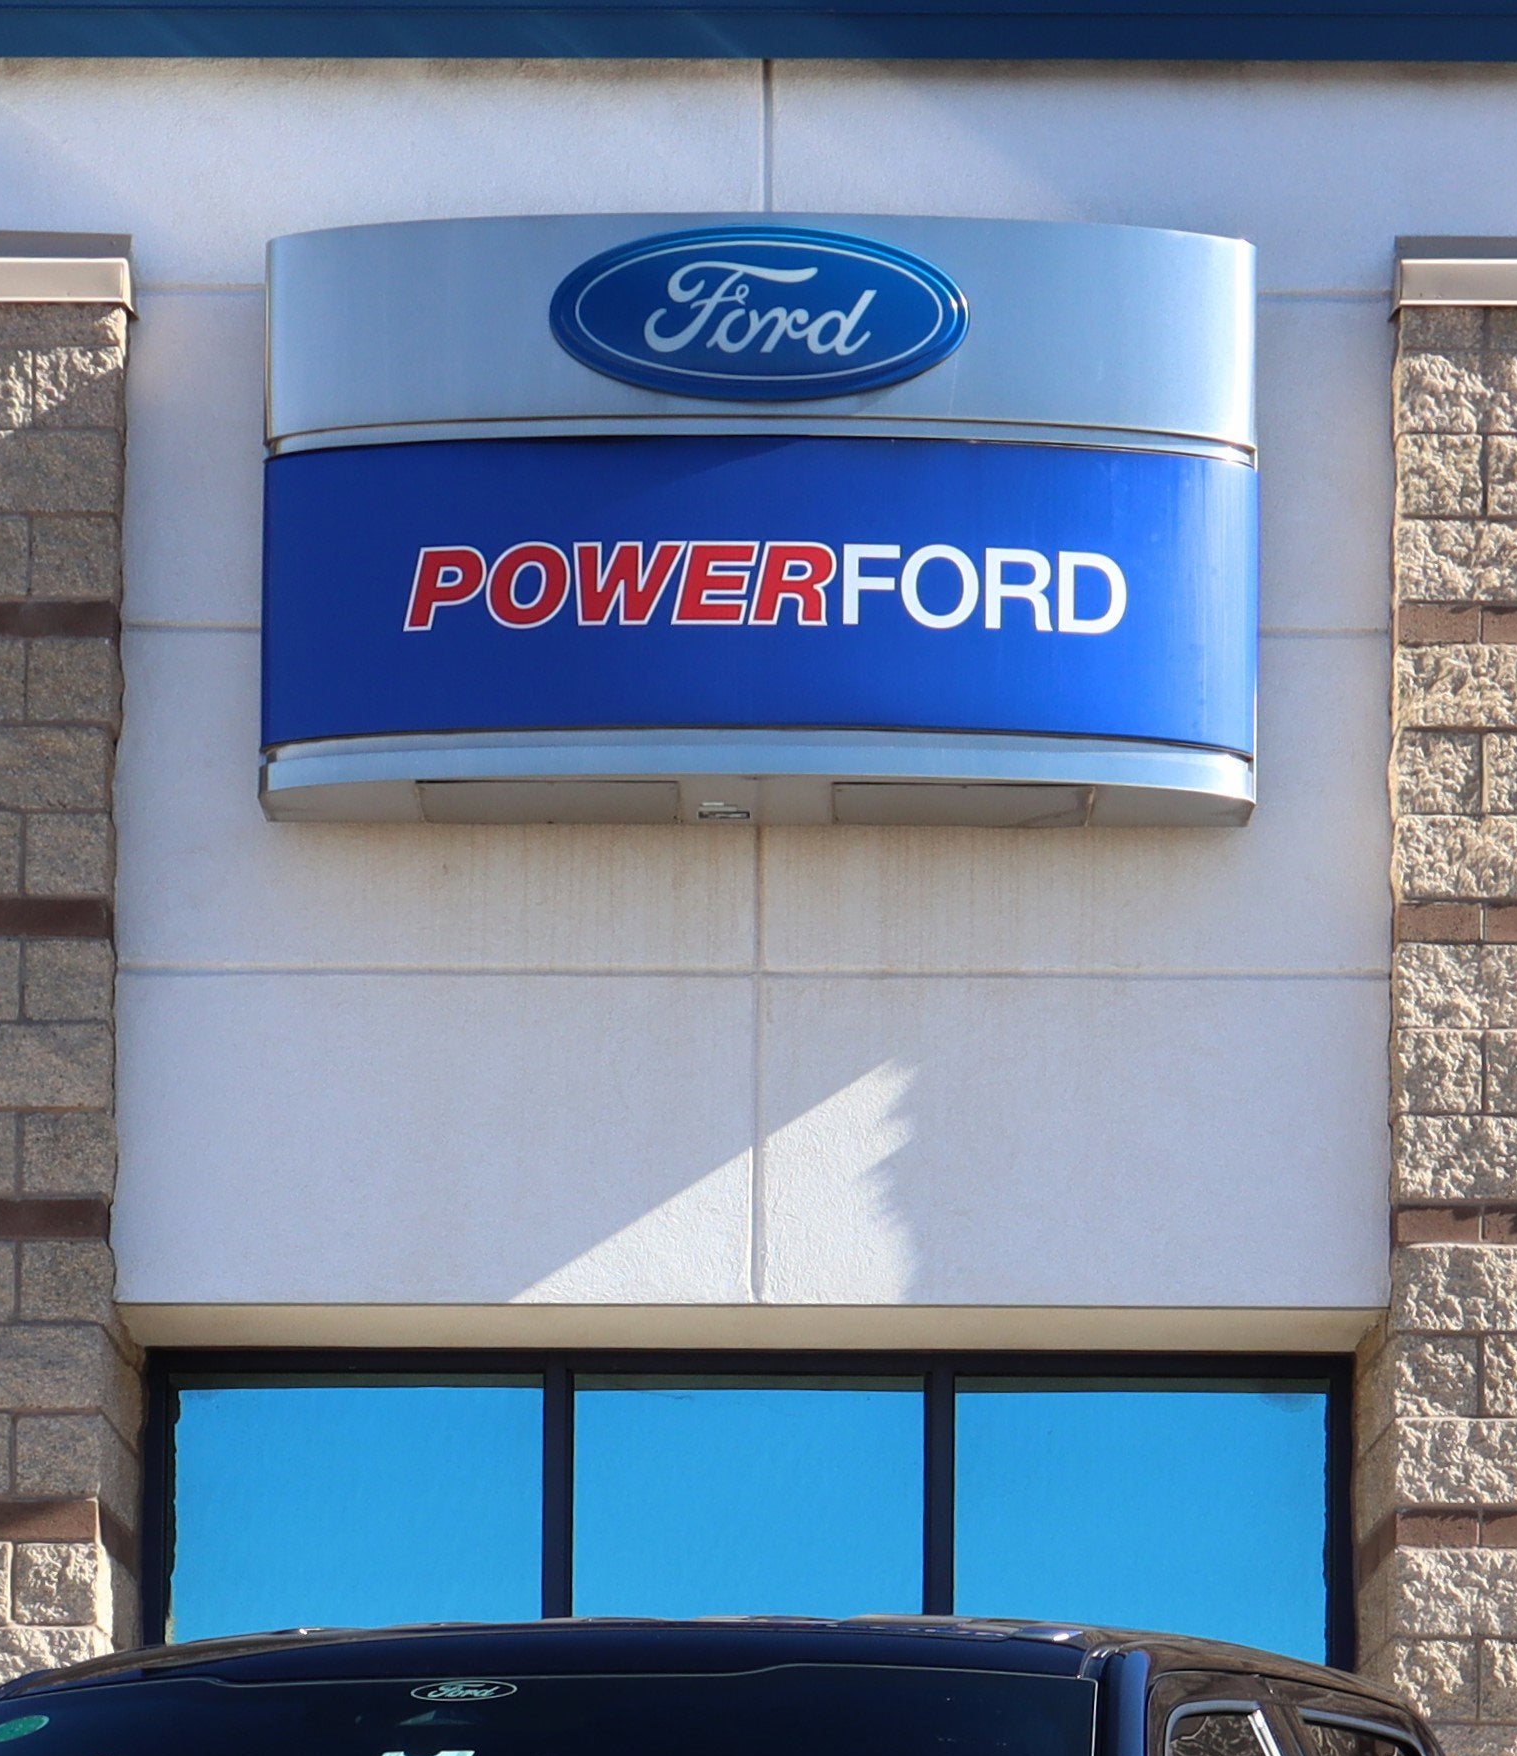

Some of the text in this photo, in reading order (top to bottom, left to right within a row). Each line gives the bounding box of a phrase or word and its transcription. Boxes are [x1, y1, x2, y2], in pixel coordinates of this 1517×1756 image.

[643, 259, 875, 357] Ford
[403, 540, 1127, 635] POWERFORD
[427, 1682, 500, 1698] Ford
